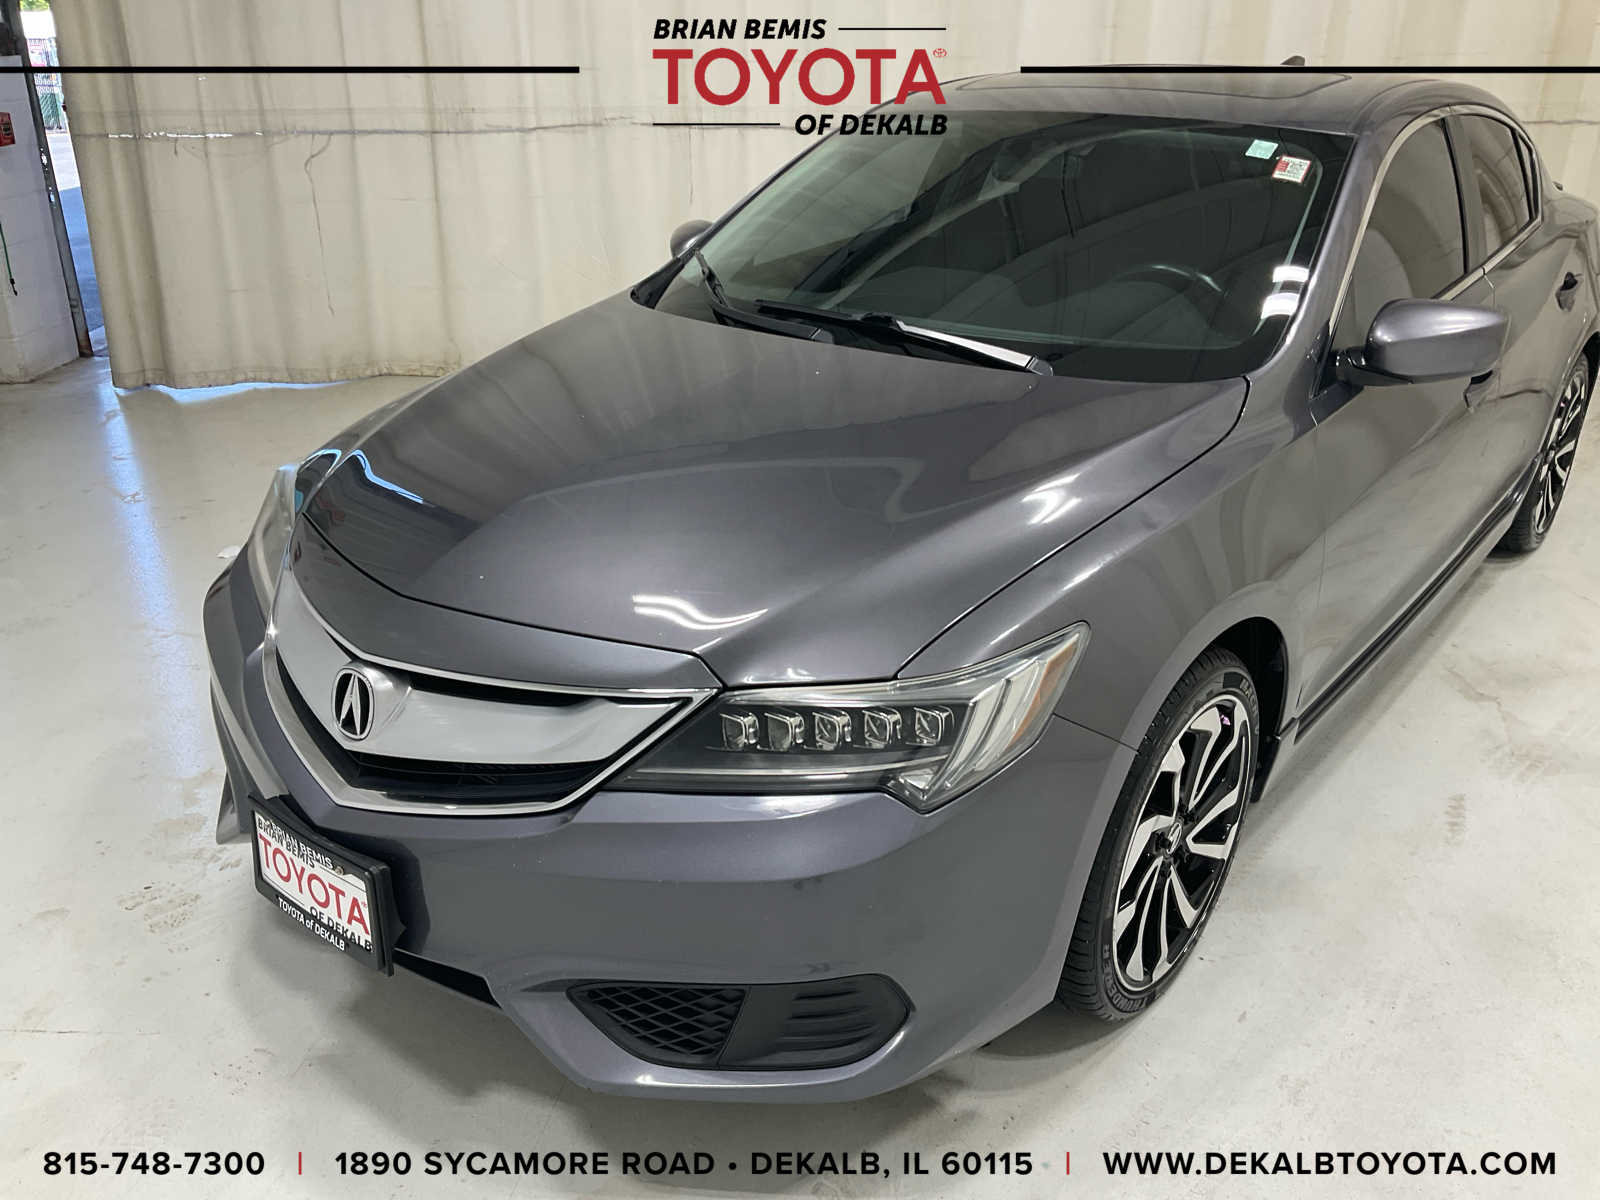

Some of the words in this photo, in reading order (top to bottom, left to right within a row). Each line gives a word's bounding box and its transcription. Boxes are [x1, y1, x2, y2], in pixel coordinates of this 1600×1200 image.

[299, 842, 334, 869] BEMIS
[259, 833, 370, 936] TOYOTA
[278, 896, 305, 925] TOYOTA
[305, 919, 314, 931] of
[314, 923, 345, 951] DEKALB
[327, 916, 372, 953] DEKALB
